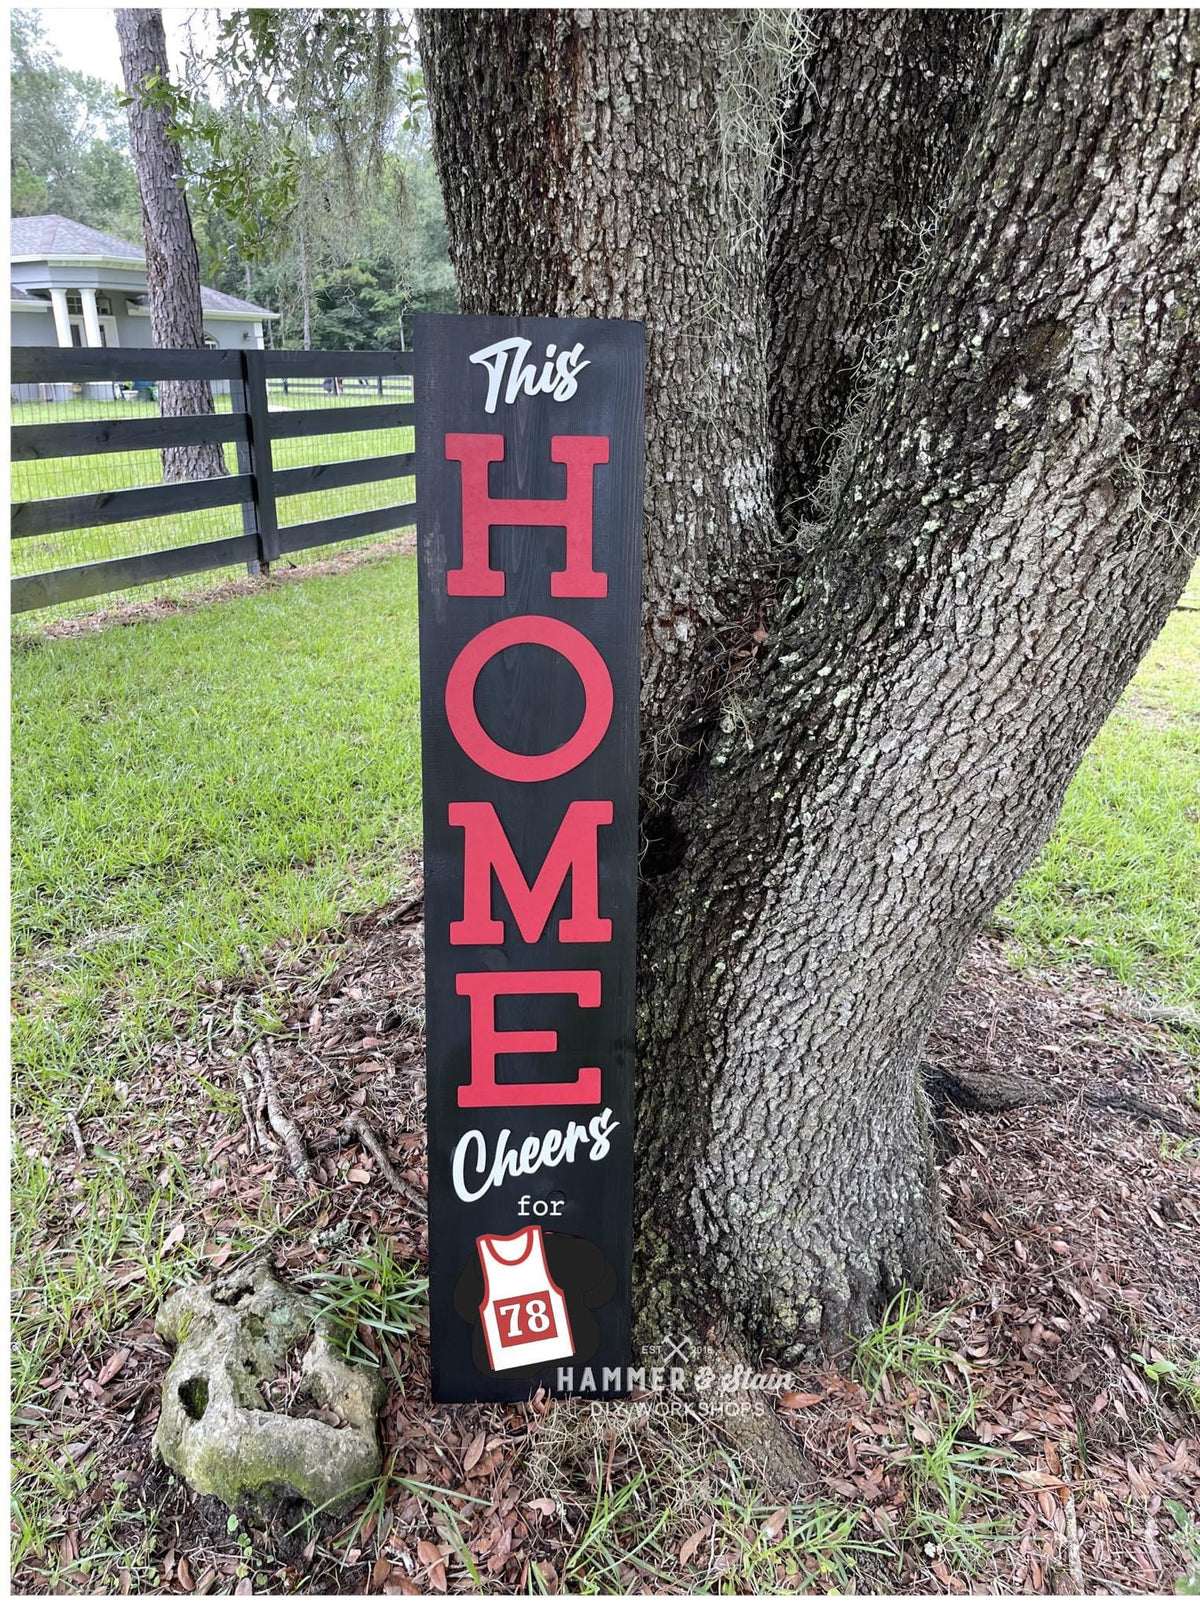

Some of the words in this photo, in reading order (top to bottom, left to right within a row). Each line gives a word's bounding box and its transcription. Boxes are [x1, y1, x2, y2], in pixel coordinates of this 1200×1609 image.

[469, 336, 591, 414] This
[444, 432, 614, 1108] HOME
[452, 1107, 620, 1203] Cheers
[517, 1195, 565, 1217] for
[499, 1299, 551, 1338] 78
